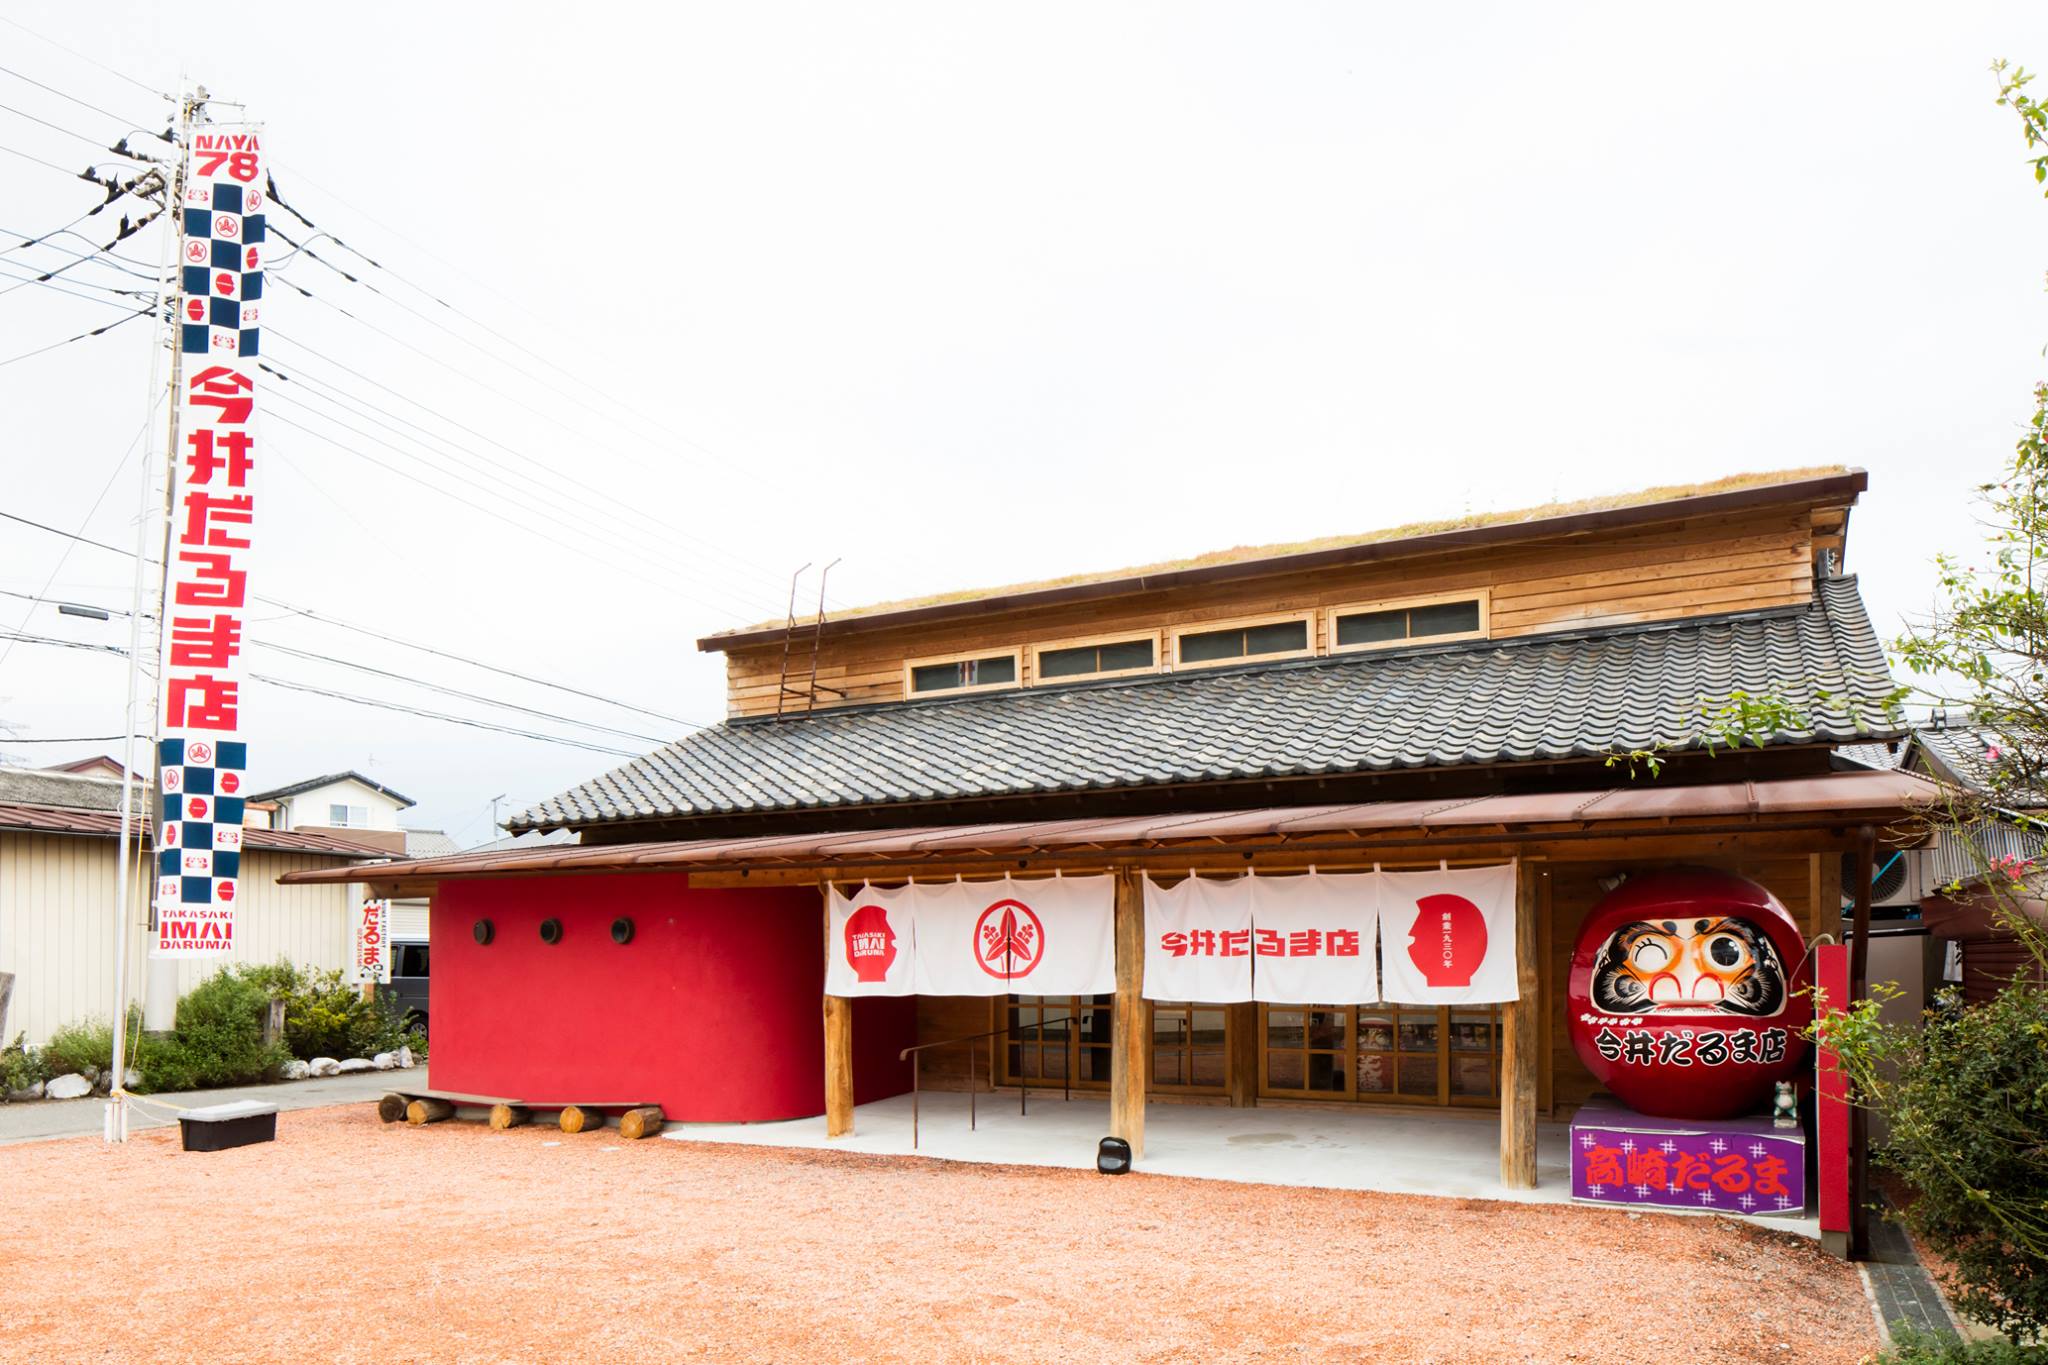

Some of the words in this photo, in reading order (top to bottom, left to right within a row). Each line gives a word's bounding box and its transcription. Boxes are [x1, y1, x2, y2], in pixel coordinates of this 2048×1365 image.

[196, 134, 260, 151] NAYA
[195, 151, 259, 182] 78
[166, 365, 254, 731] 今井だるま店
[162, 910, 233, 919] TAKASAKI
[160, 921, 233, 939] IMAI
[159, 940, 232, 950] DARUMA
[852, 937, 886, 951] IMAI
[1161, 928, 1360, 958] 今井だるま店
[1595, 1027, 1787, 1066] 今井だるま店
[1583, 1145, 1790, 1197] 高崎だるま
